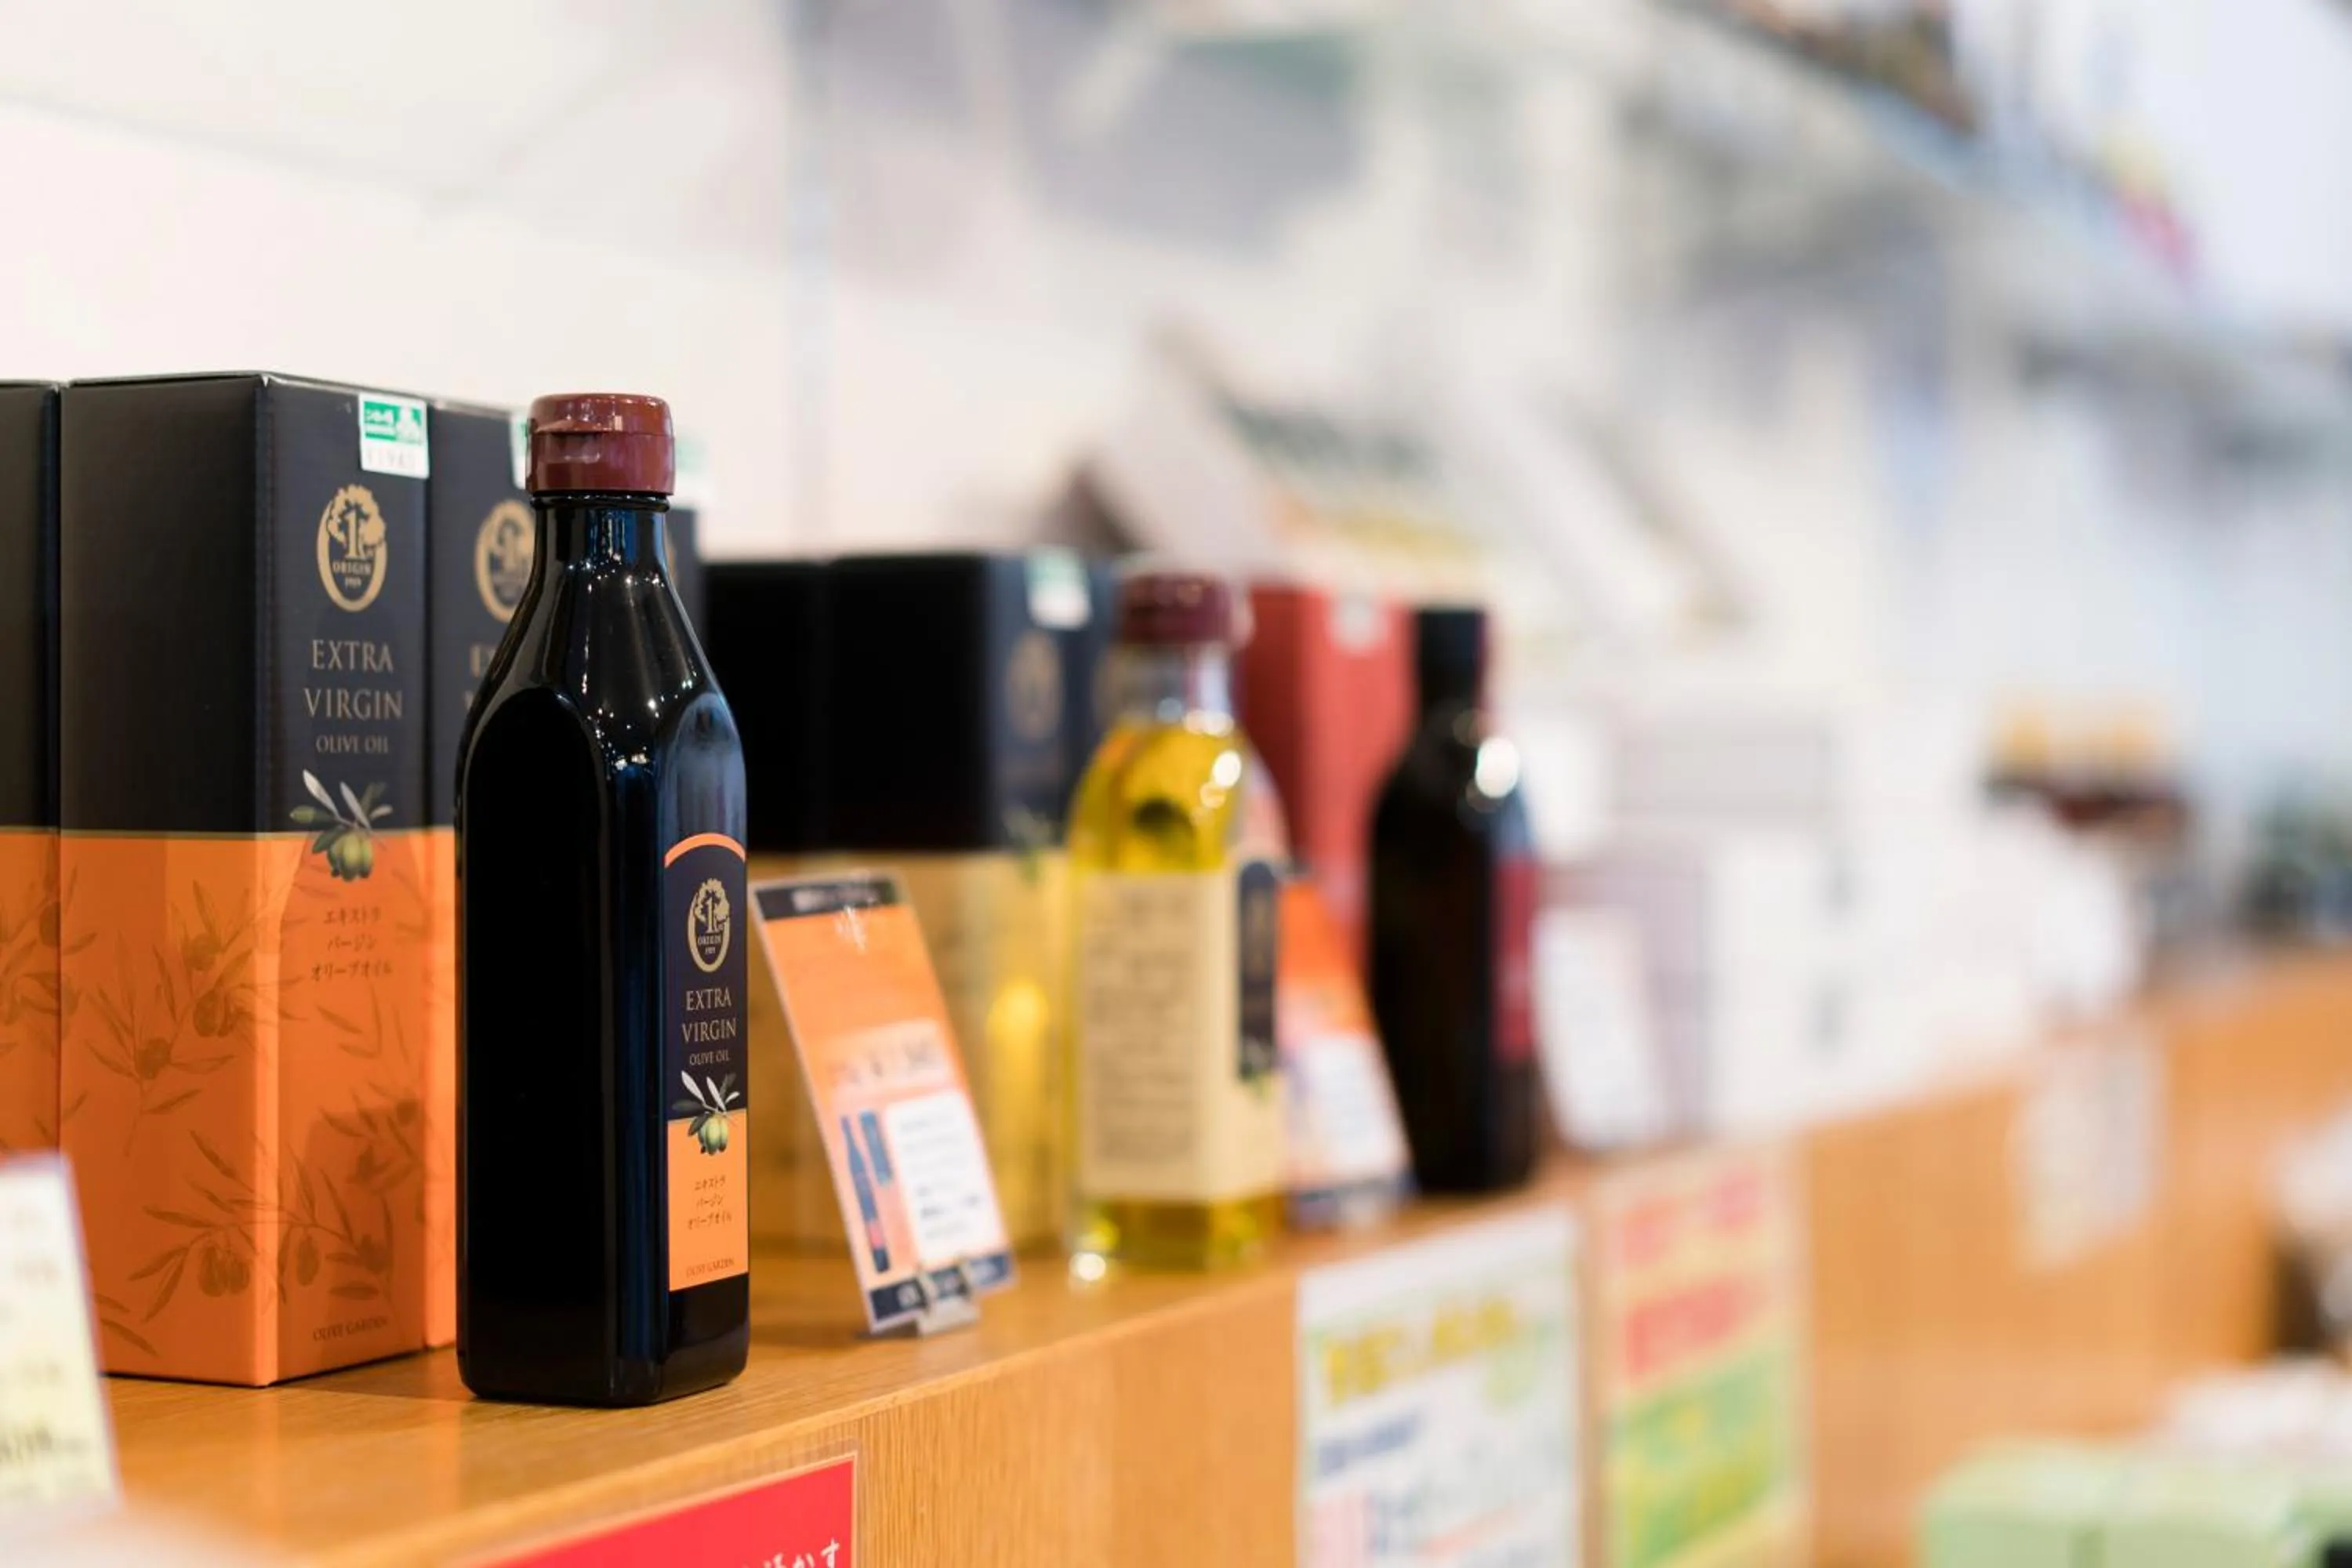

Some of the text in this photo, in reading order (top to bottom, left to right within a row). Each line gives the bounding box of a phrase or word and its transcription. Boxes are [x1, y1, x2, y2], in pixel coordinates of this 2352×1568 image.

[332, 560, 372, 575] ORIGIN
[312, 639, 394, 673] EXTRA
[303, 688, 402, 721] VIRGIN
[316, 734, 390, 754] OLIVE OIL
[686, 986, 732, 1011] EXTRA
[682, 1018, 737, 1043] VIRGIN
[689, 1048, 730, 1066] OLIVE OIL
[707, 1257, 735, 1272] GARDEN
[346, 1316, 388, 1335] GARDEN
